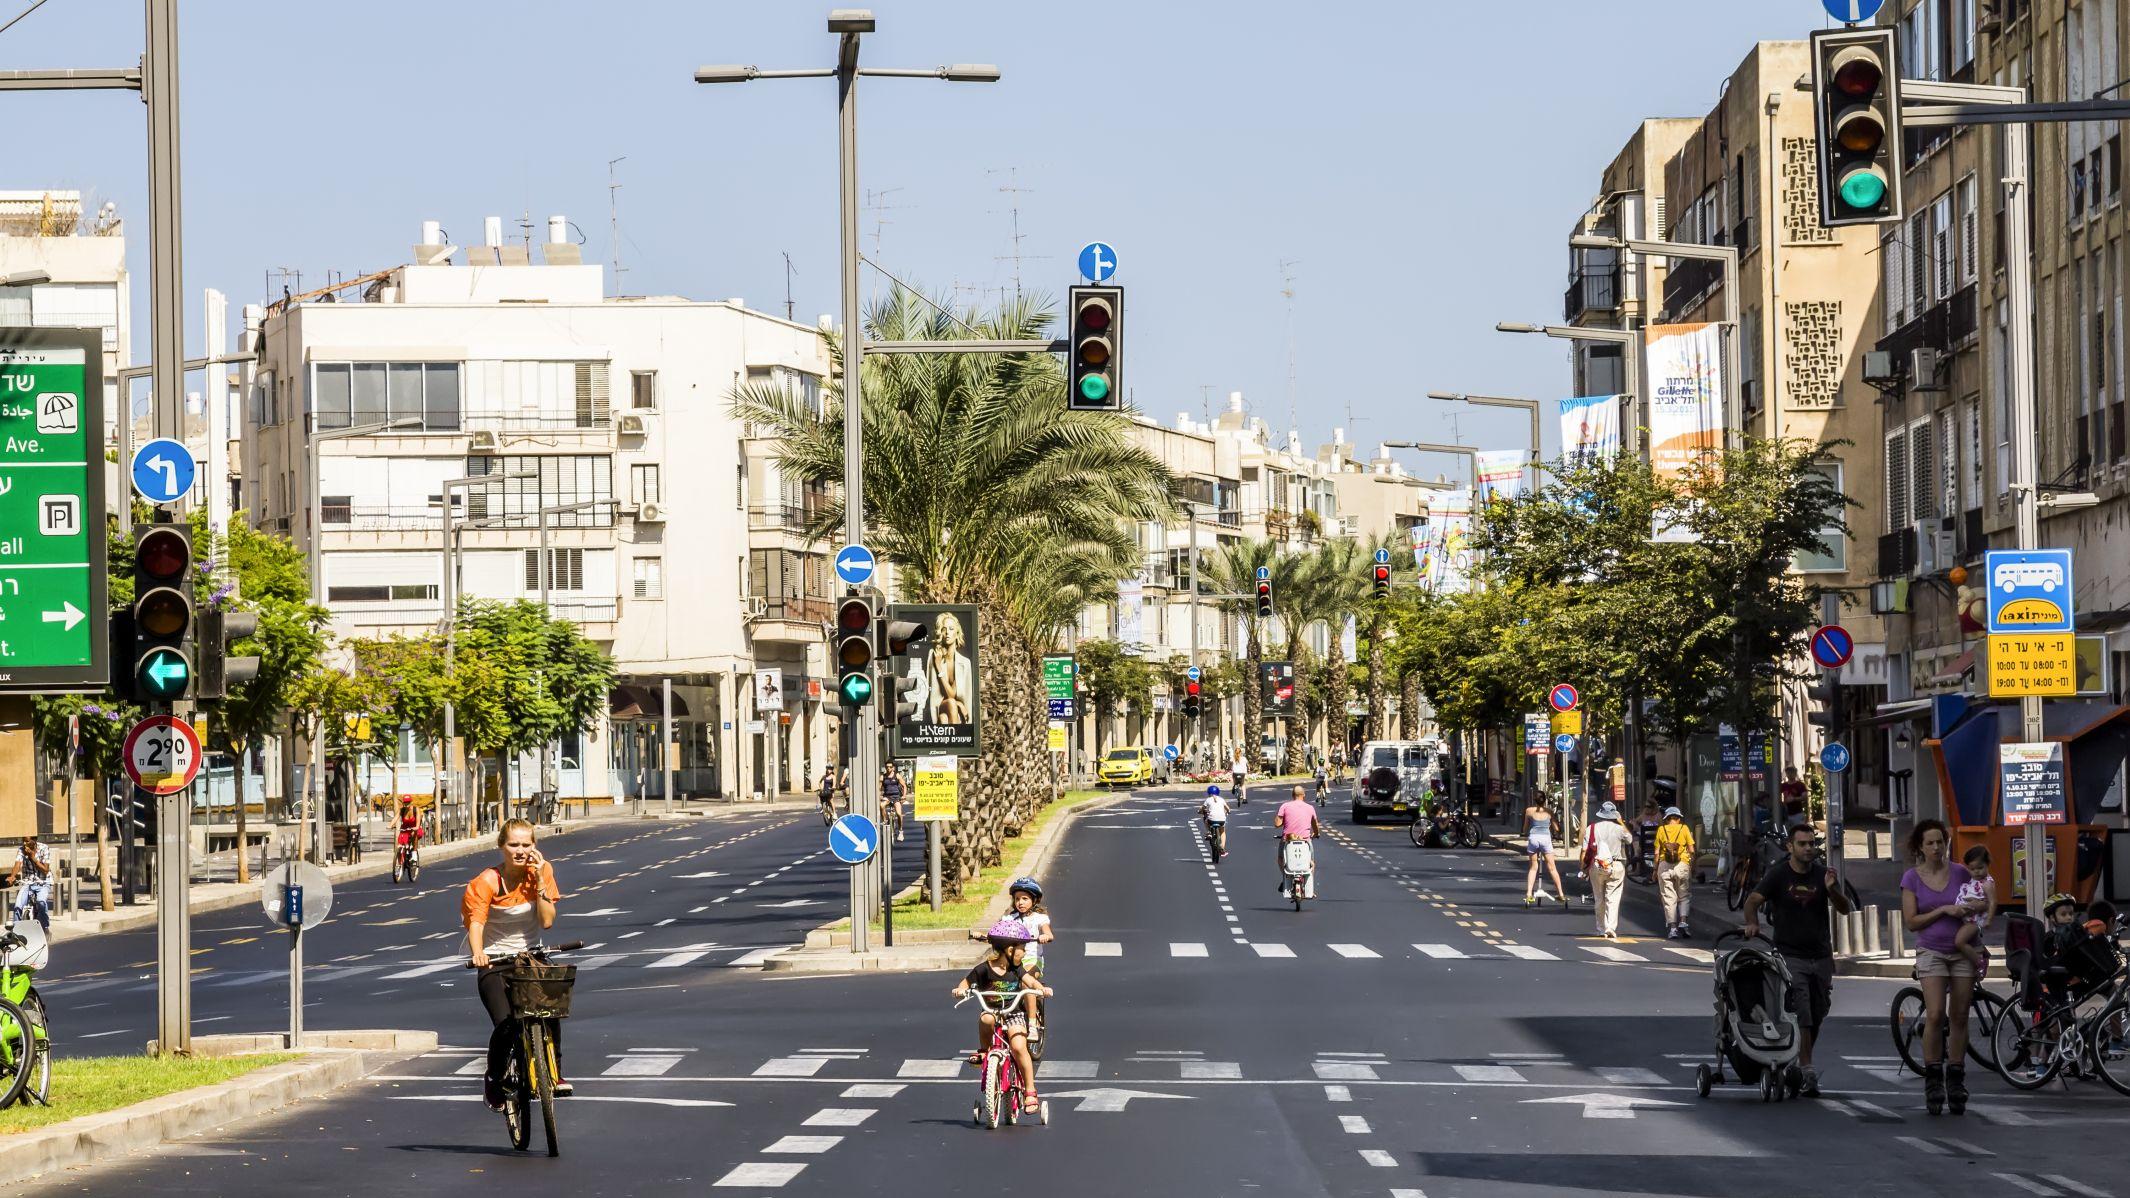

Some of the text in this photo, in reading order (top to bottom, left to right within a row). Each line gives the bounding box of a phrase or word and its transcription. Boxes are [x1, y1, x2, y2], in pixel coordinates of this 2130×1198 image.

[2, 375, 35, 392] שד
[1666, 377, 1694, 386] מרתון
[1657, 386, 1696, 396] Gillette
[2, 404, 33, 420] جادة
[6, 436, 44, 453] Ave.
[2004, 606, 2029, 620] taxi
[2015, 642, 2028, 653] עד
[1997, 661, 2016, 671] 10:00
[2020, 661, 2030, 671] עד
[2033, 660, 2054, 670] 08:00
[1996, 678, 2016, 688] 19:00
[2033, 677, 2053, 687] 14:00
[1699, 754, 1715, 766] Dior
[2021, 763, 2043, 772] סובב
